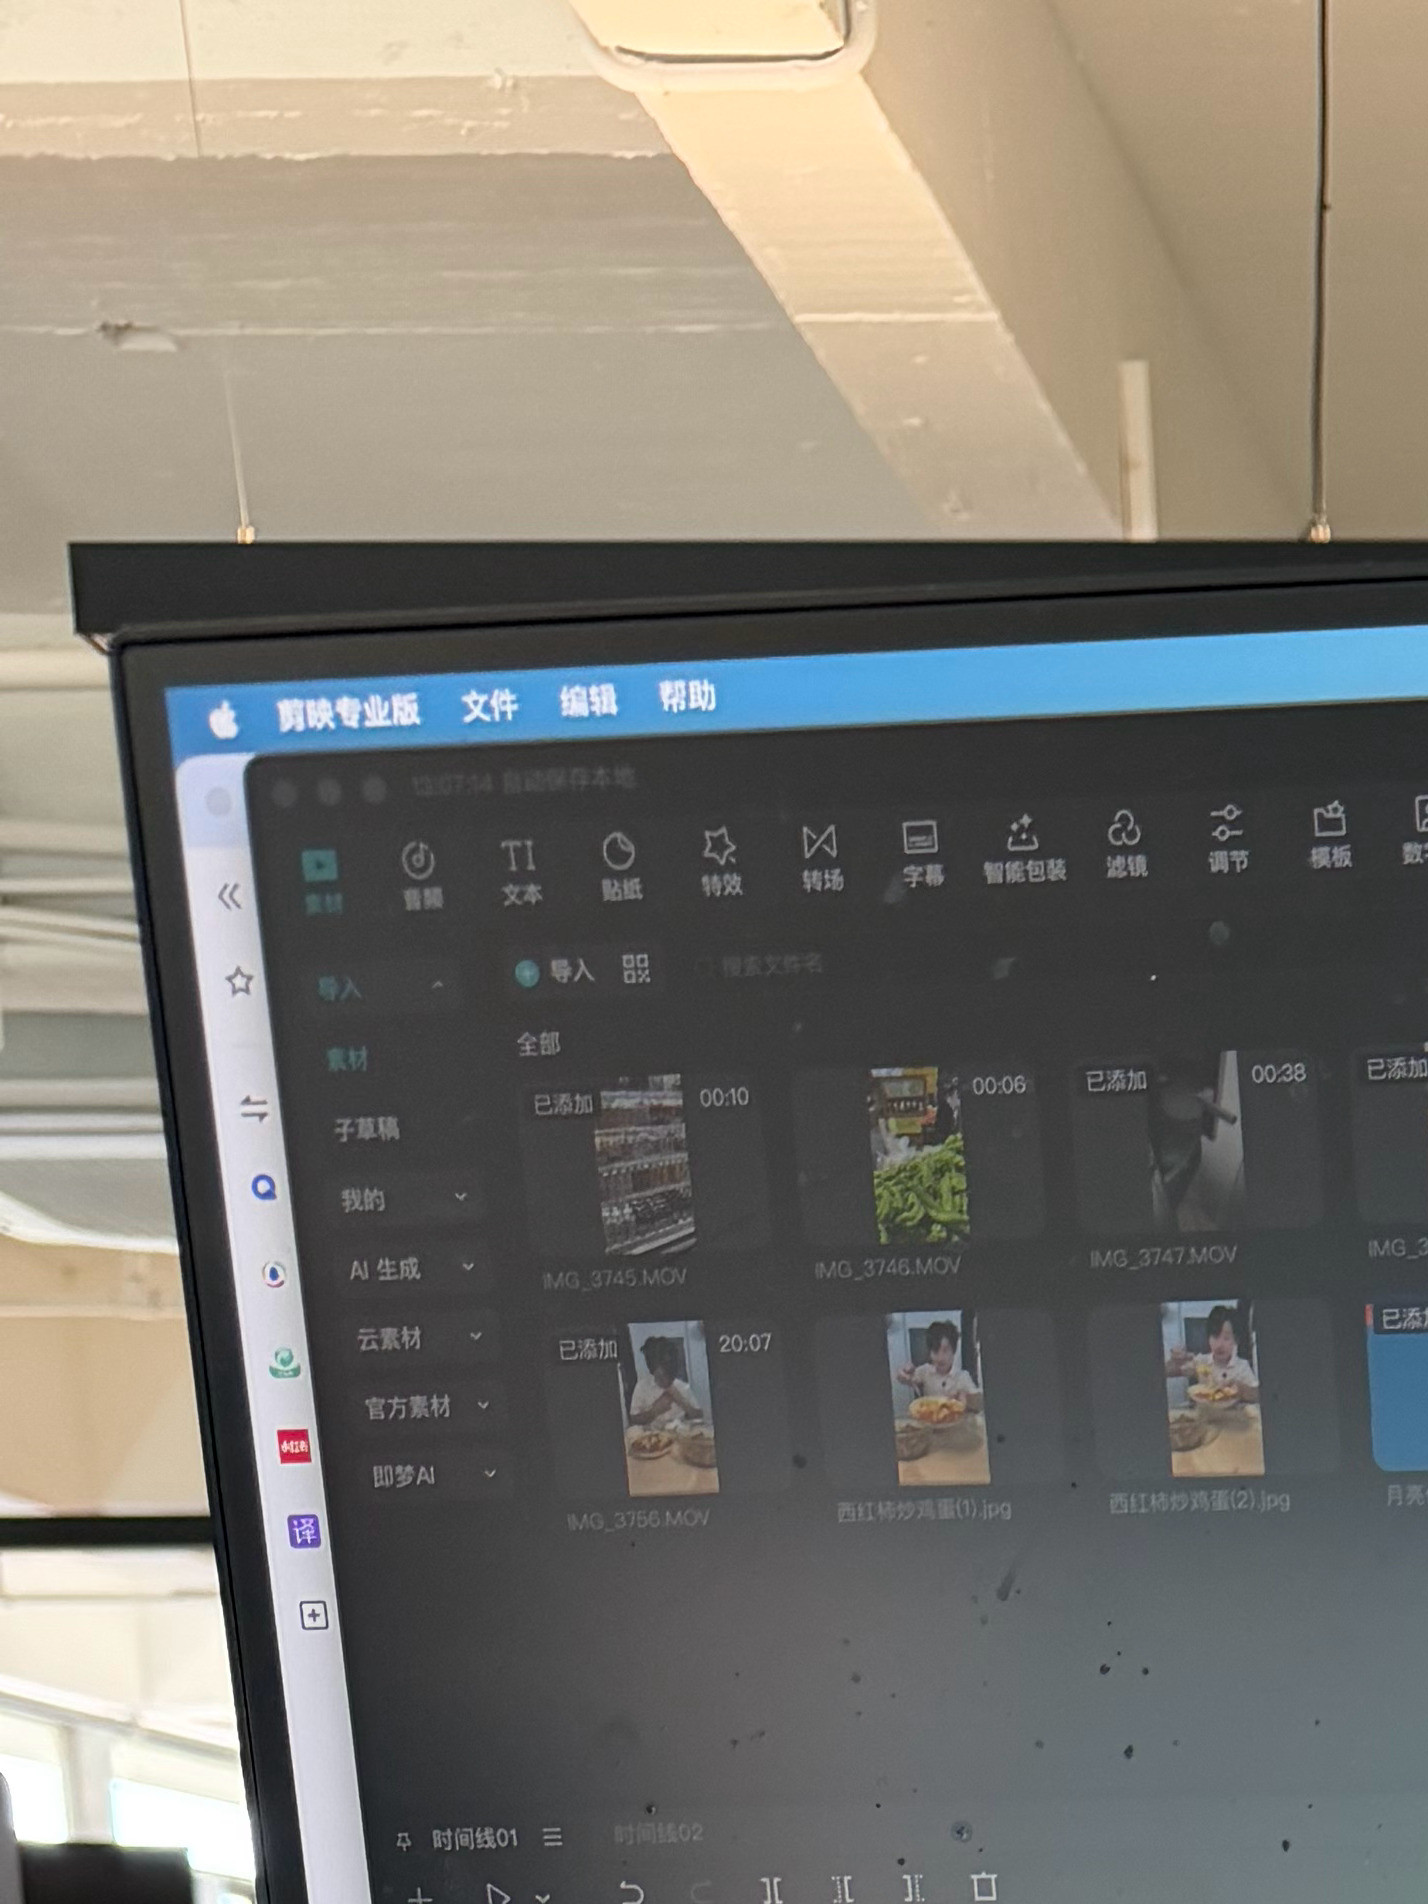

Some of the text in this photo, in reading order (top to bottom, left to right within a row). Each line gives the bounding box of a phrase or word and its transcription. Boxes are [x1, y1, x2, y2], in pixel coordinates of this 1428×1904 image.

[462, 689, 518, 724] 文件
[559, 683, 618, 719] 编辑
[659, 679, 717, 714] 帮助
[277, 693, 421, 733] 剪映专业版
[1106, 855, 1148, 878] 滤镜
[1209, 849, 1249, 873] 调节
[1310, 845, 1353, 869] 模板
[802, 868, 844, 893] 转场
[902, 863, 944, 888] 字幕
[983, 860, 1067, 885] 智能包装
[502, 883, 543, 905] 文本
[602, 877, 643, 902] 贴纸
[702, 873, 743, 897] 特效
[550, 959, 595, 983] 导入
[517, 1032, 561, 1056] 全部
[1251, 1063, 1307, 1084] 00:38
[1367, 1056, 1428, 1080] 已添加
[972, 1075, 1027, 1096] 00:06
[1086, 1069, 1147, 1093] 已添加
[533, 1093, 593, 1116] 已添加
[700, 1087, 749, 1107] 00:10
[334, 1117, 400, 1142] 子草稿
[341, 1187, 386, 1213] 我的
[351, 1257, 421, 1281] AI 生成
[1090, 1245, 1237, 1270] IMG_3747.MOV
[357, 1327, 422, 1351] 云素材
[558, 1337, 619, 1361] 已添加
[719, 1333, 772, 1355] 20:07
[365, 1396, 451, 1421] 官方素材
[373, 1464, 435, 1488] 即梦AI
[291, 1517, 318, 1544] 译
[432, 1827, 518, 1851] 时间线01
